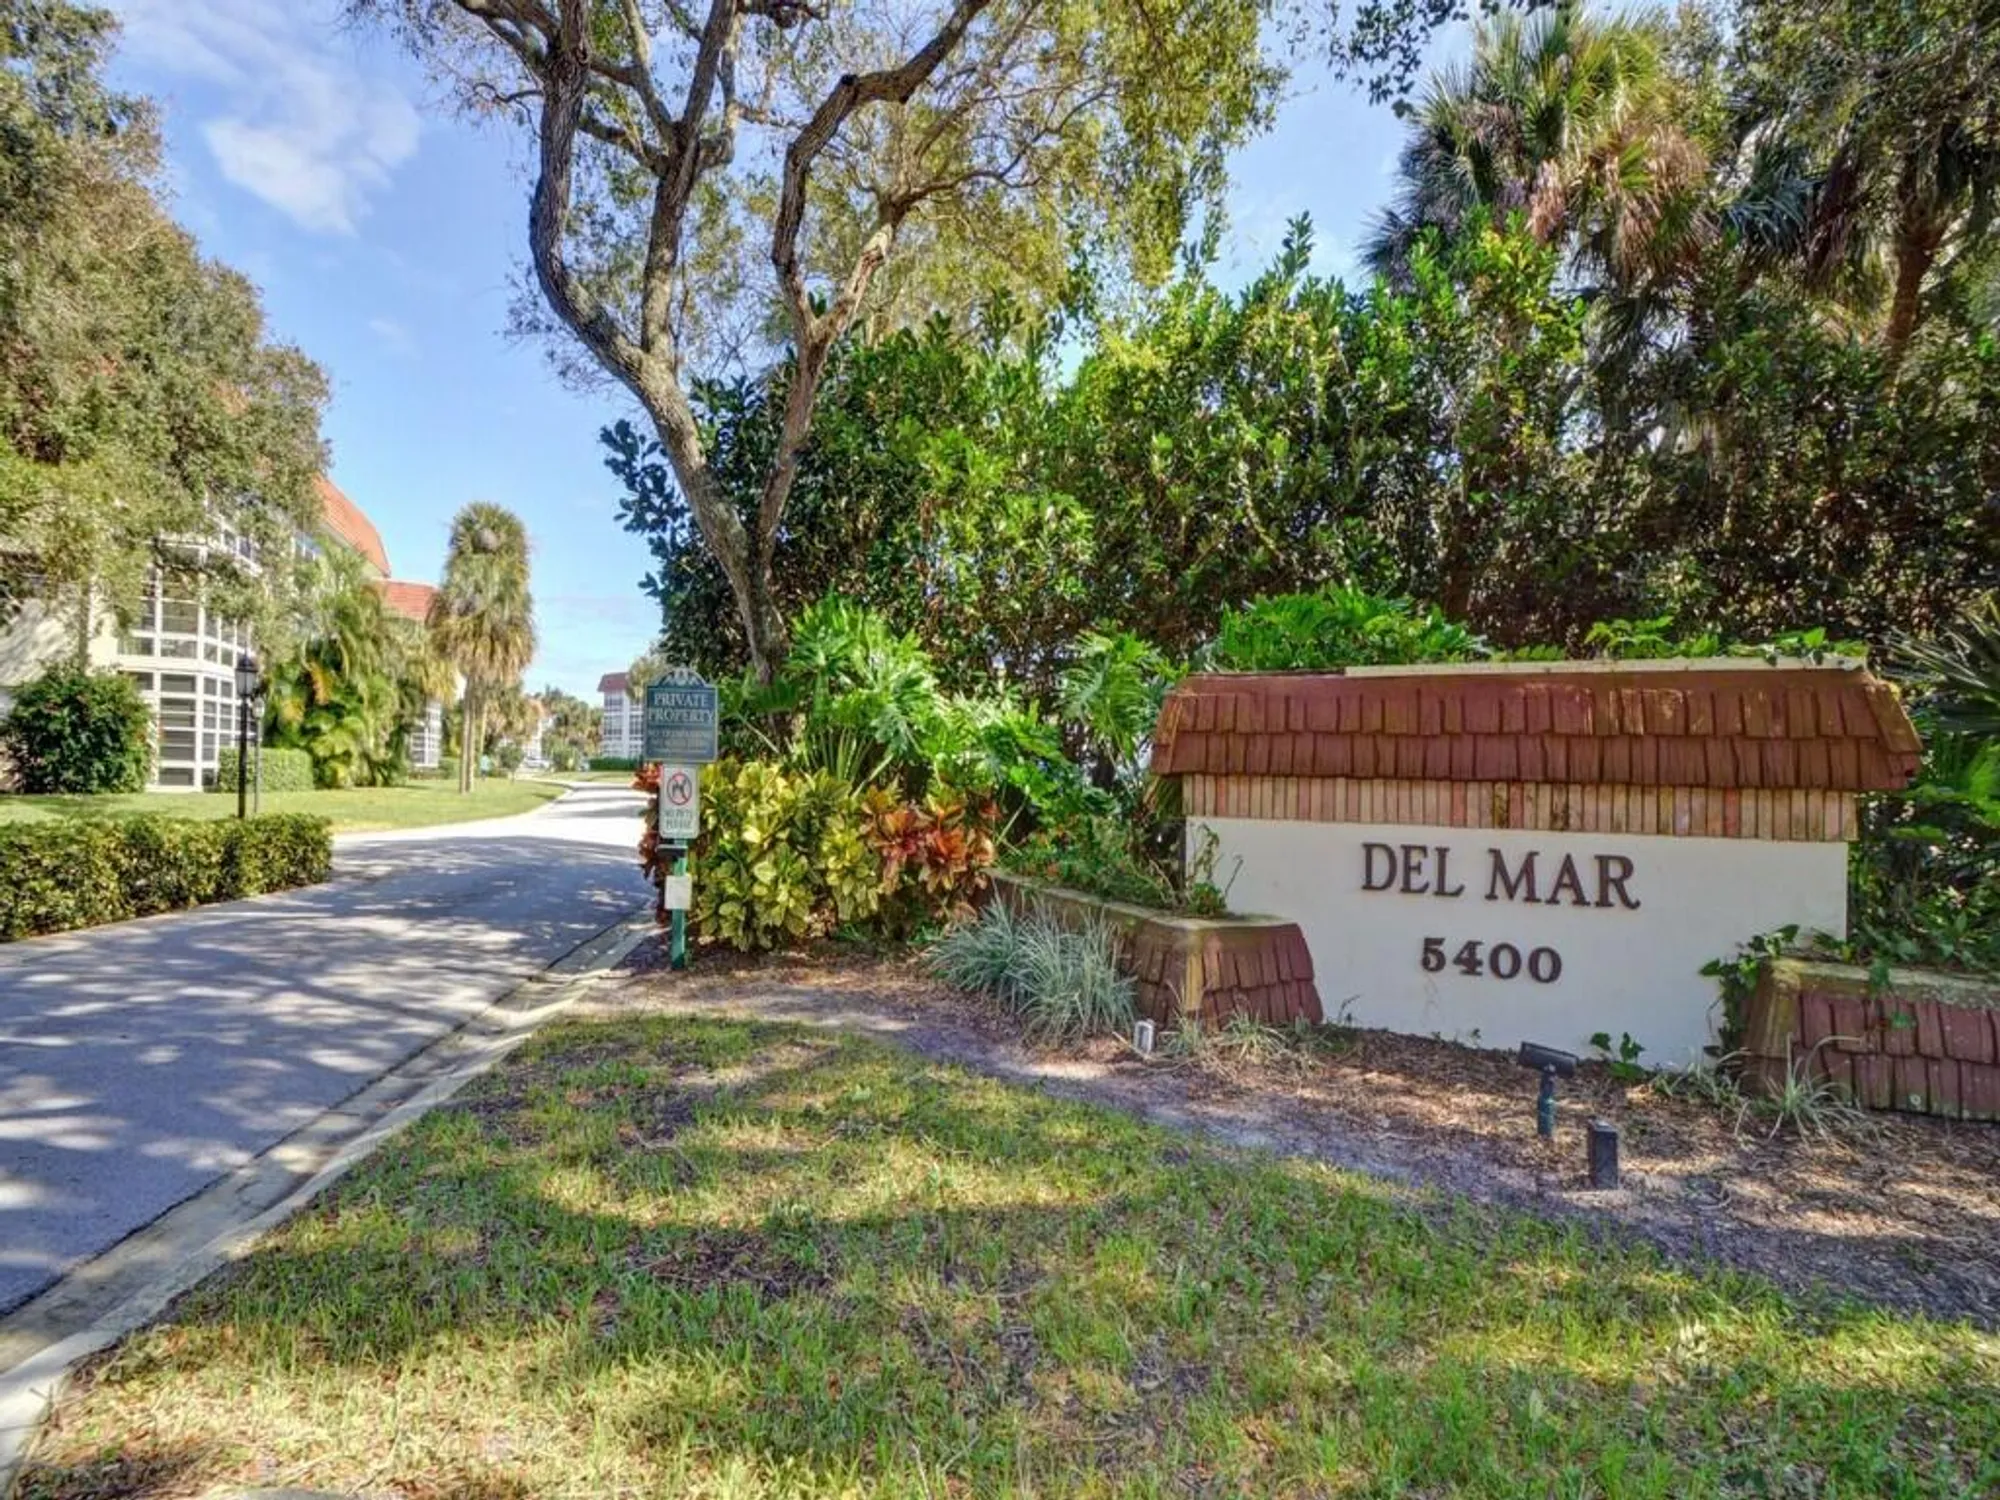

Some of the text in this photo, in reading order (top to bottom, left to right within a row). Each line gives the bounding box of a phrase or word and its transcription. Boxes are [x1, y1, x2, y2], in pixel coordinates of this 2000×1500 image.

[654, 693, 708, 706] PRIVATE
[648, 709, 713, 723] PROPERTY
[1361, 842, 1641, 910] DEL MAR
[1421, 937, 1562, 983] 5400
